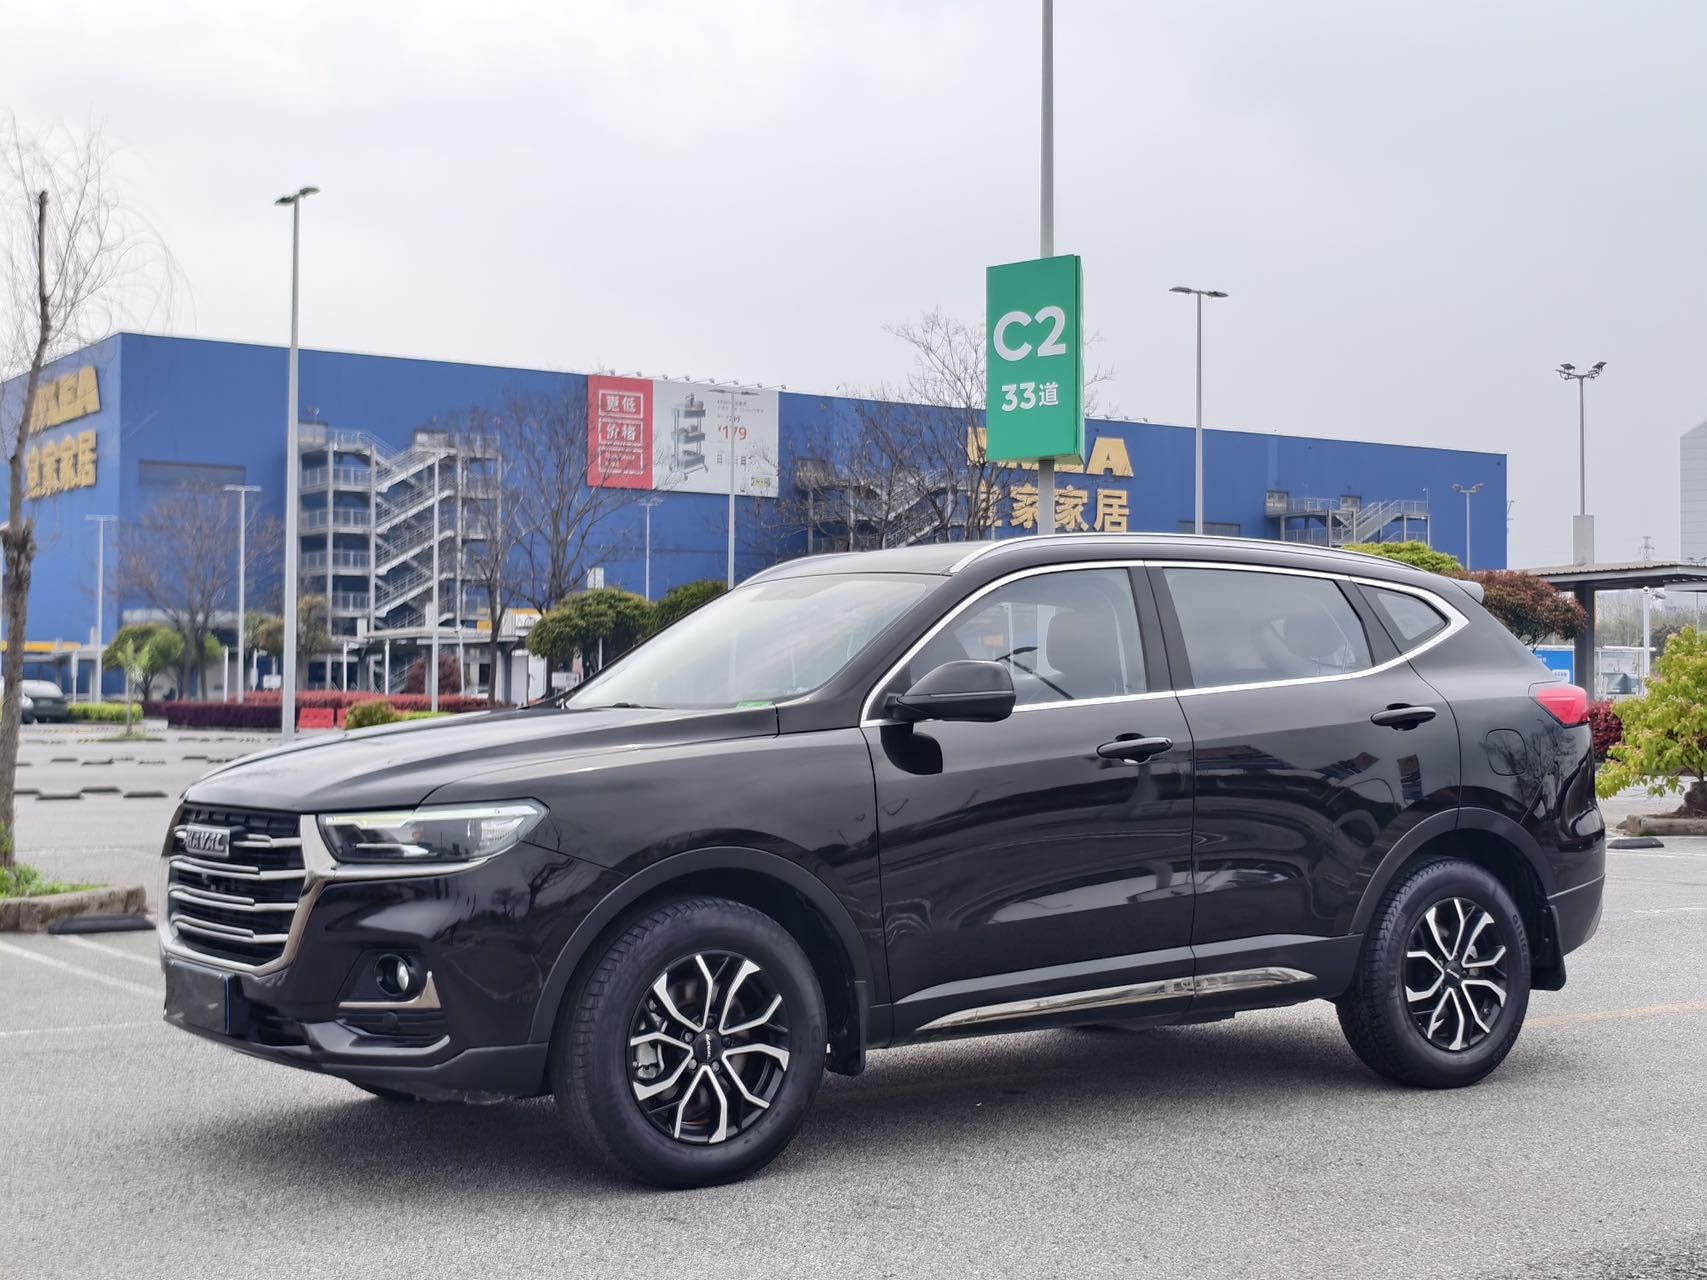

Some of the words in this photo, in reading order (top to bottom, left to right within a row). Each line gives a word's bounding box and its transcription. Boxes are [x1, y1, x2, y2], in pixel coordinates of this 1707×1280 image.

[993, 305, 1067, 362] C2
[1001, 381, 1059, 412] 33道
[186, 830, 225, 852] HAVAL
